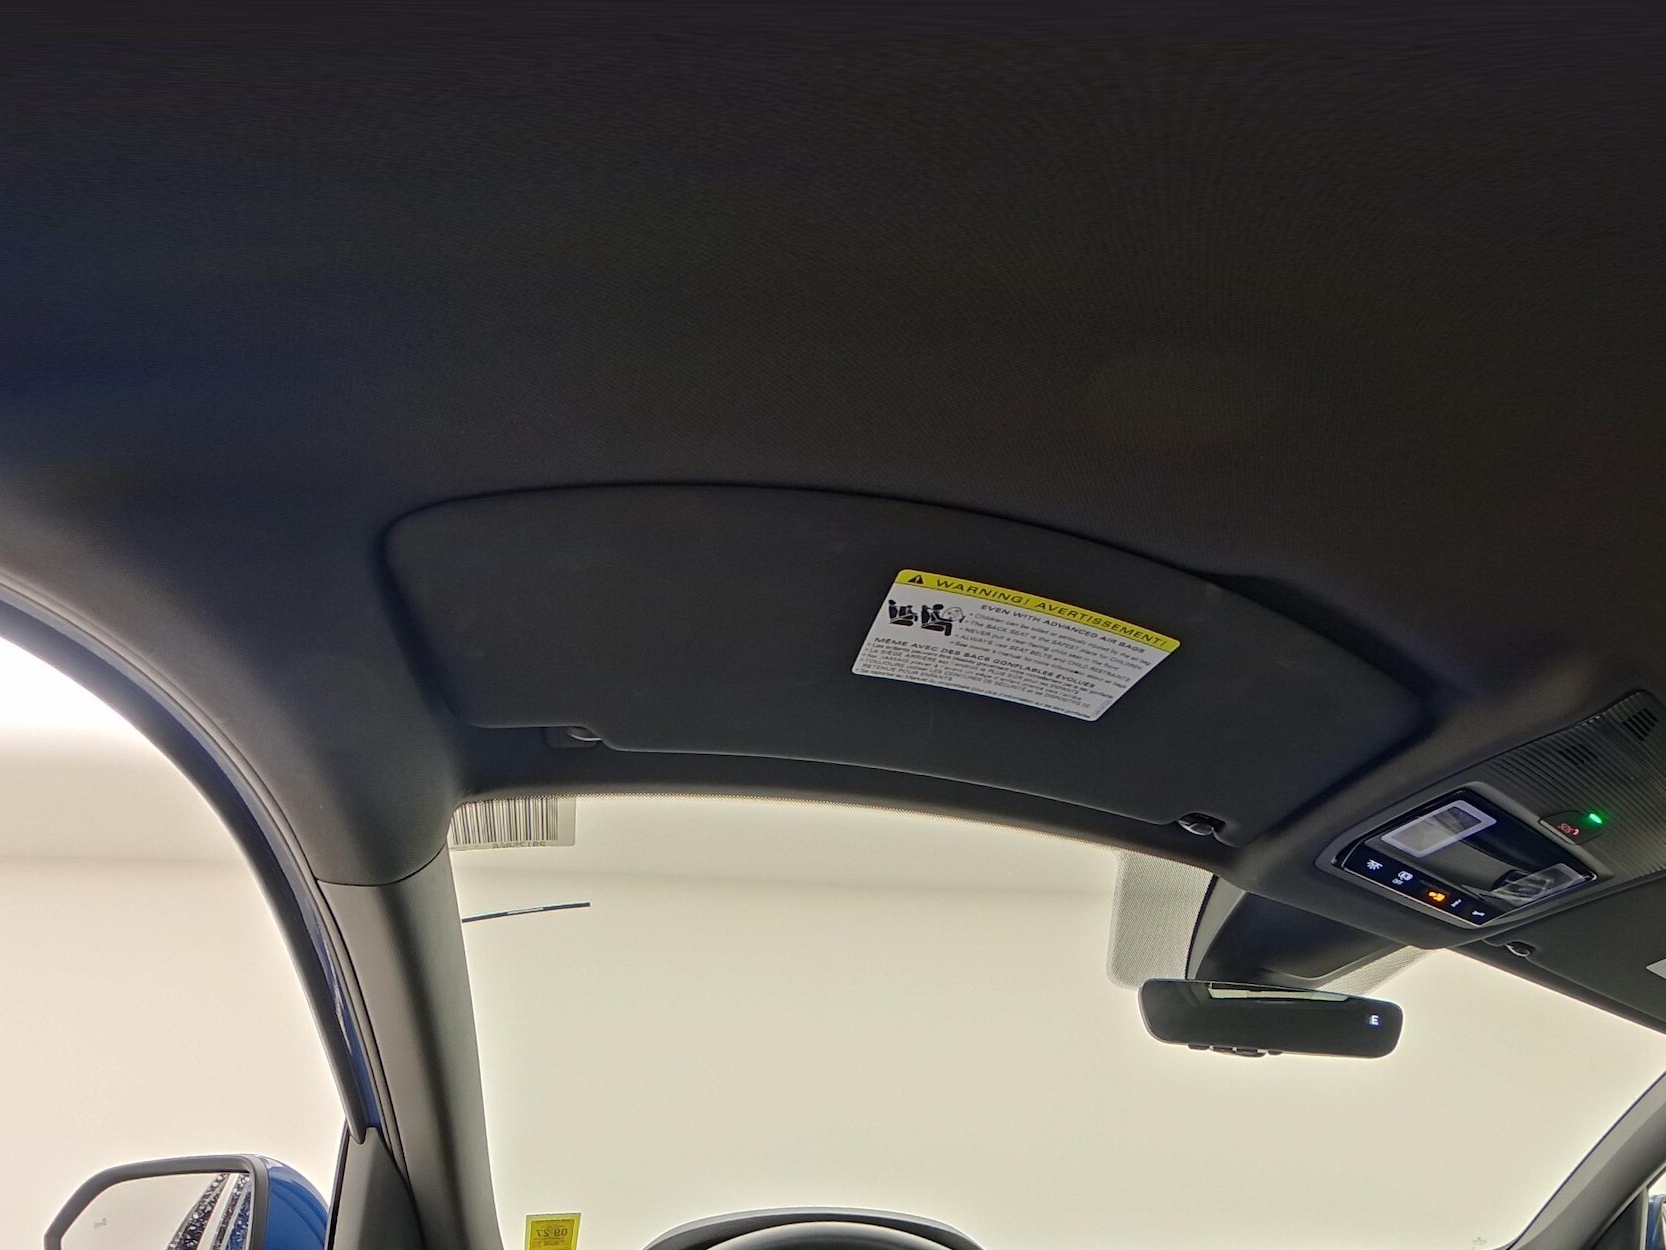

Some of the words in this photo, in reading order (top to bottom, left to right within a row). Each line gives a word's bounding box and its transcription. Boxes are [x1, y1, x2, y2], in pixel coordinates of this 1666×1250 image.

[934, 580, 1031, 604] WARNING!
[1034, 601, 1168, 646] AVERTISSEMENT!
[980, 605, 1010, 615] EVEN
[1012, 612, 1041, 622] WITH
[1042, 619, 1098, 638] ADVANCED
[1099, 635, 1117, 644] AIR
[1118, 641, 1146, 653] BAGS
[911, 642, 938, 651] AVEC
[941, 647, 961, 655] DES
